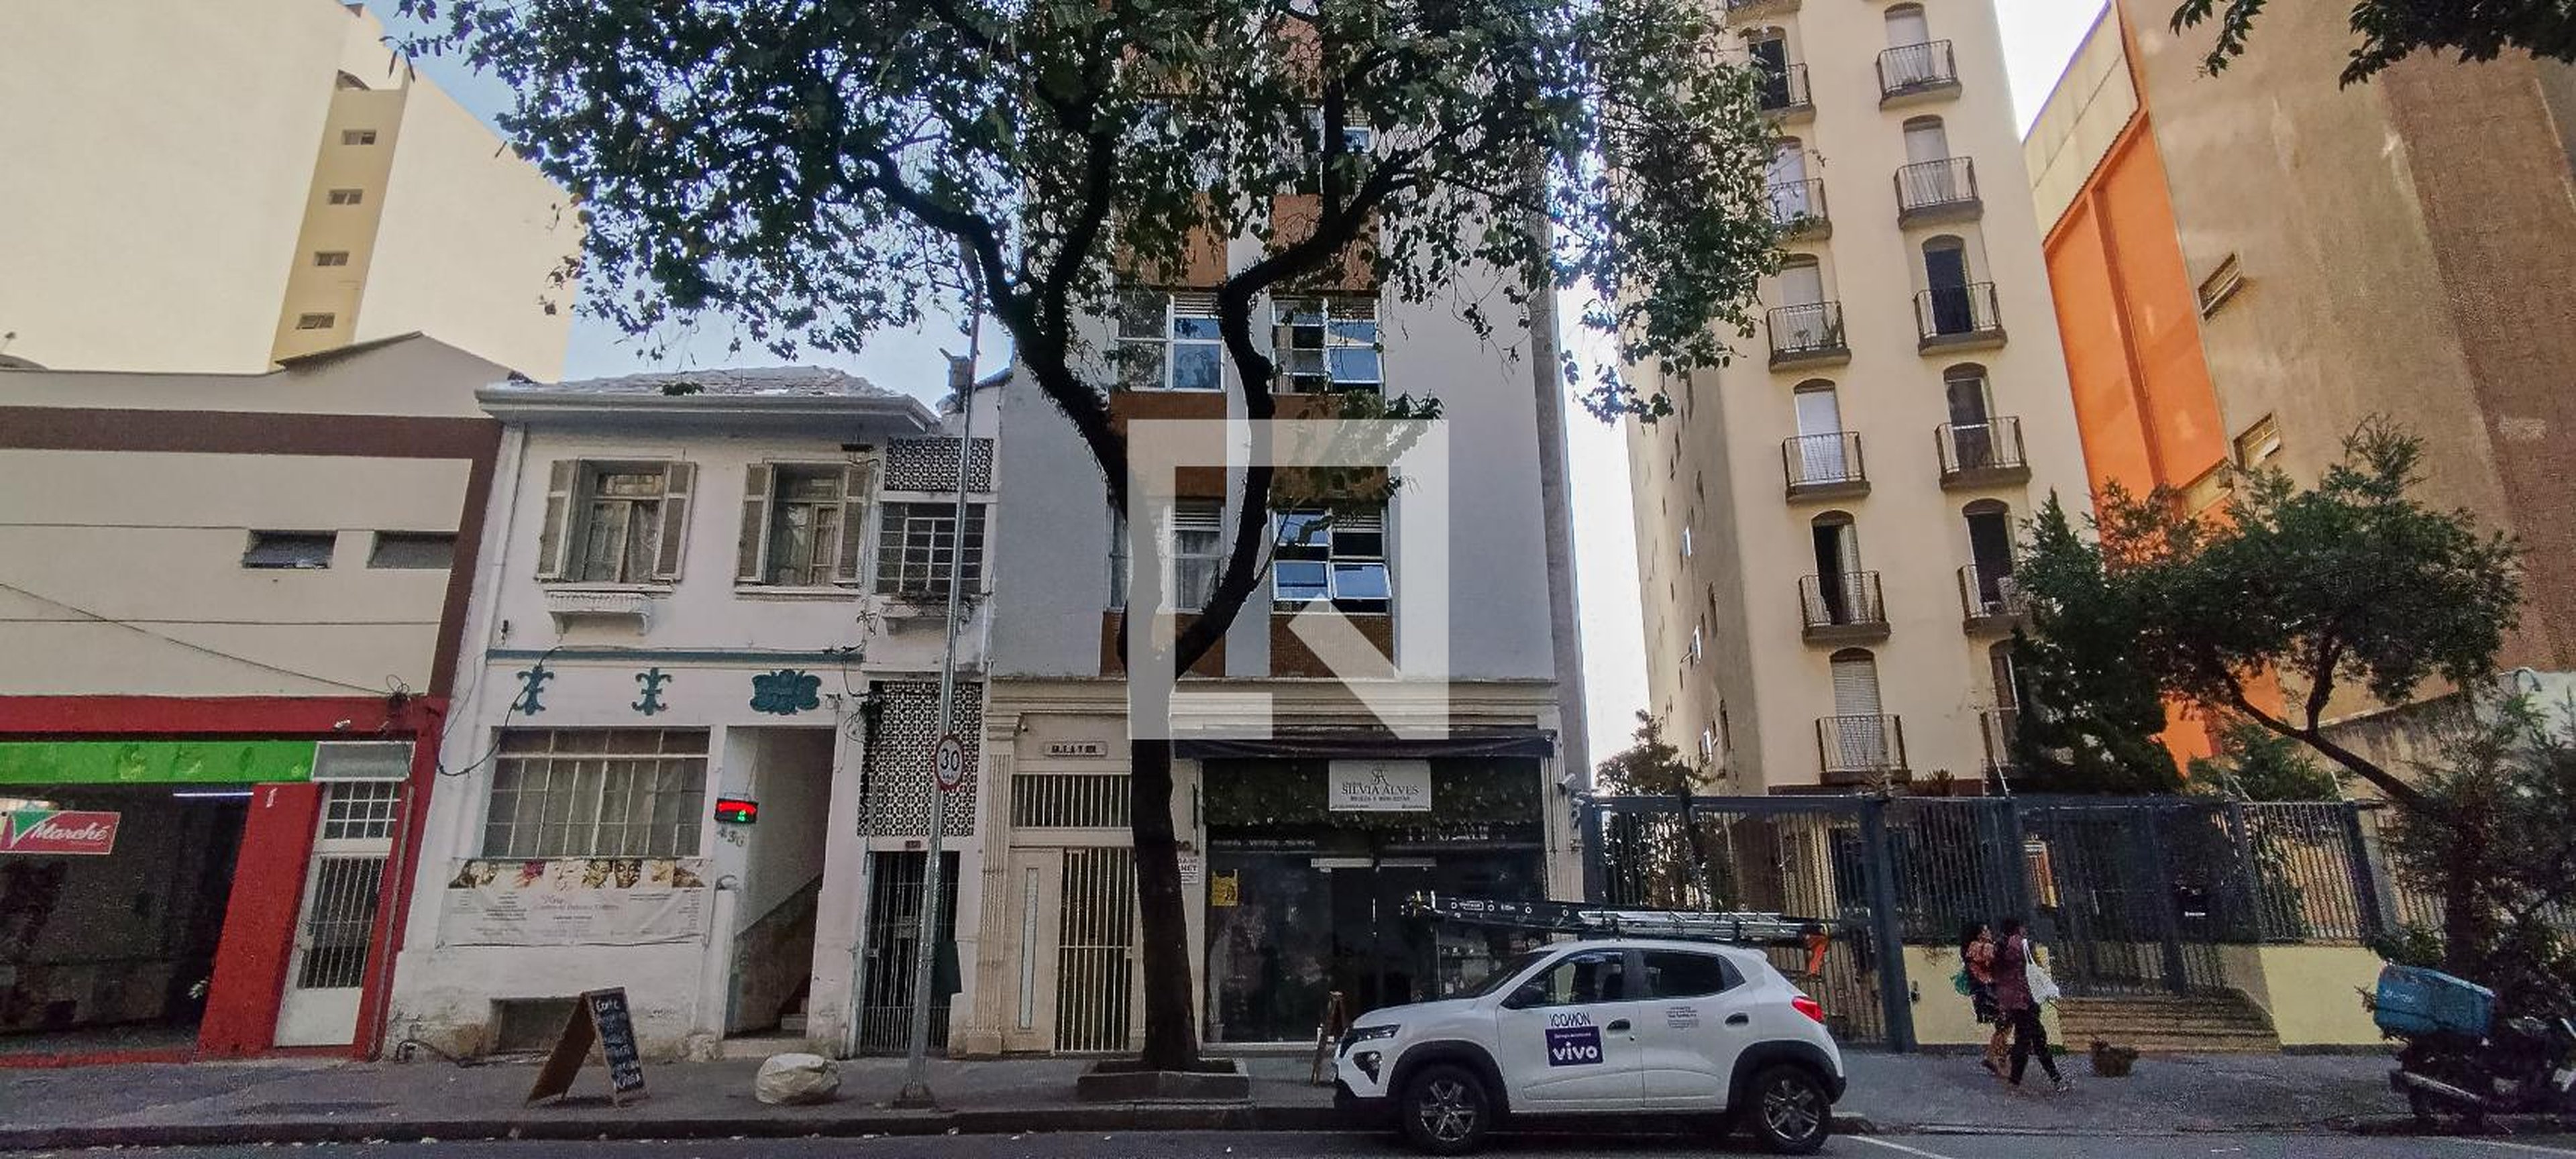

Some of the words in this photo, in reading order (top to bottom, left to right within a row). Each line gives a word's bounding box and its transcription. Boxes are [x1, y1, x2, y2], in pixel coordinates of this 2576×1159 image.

[940, 748, 960, 771] 30
[30, 822, 111, 841] Marché
[1552, 1041, 1598, 1060] vivo
